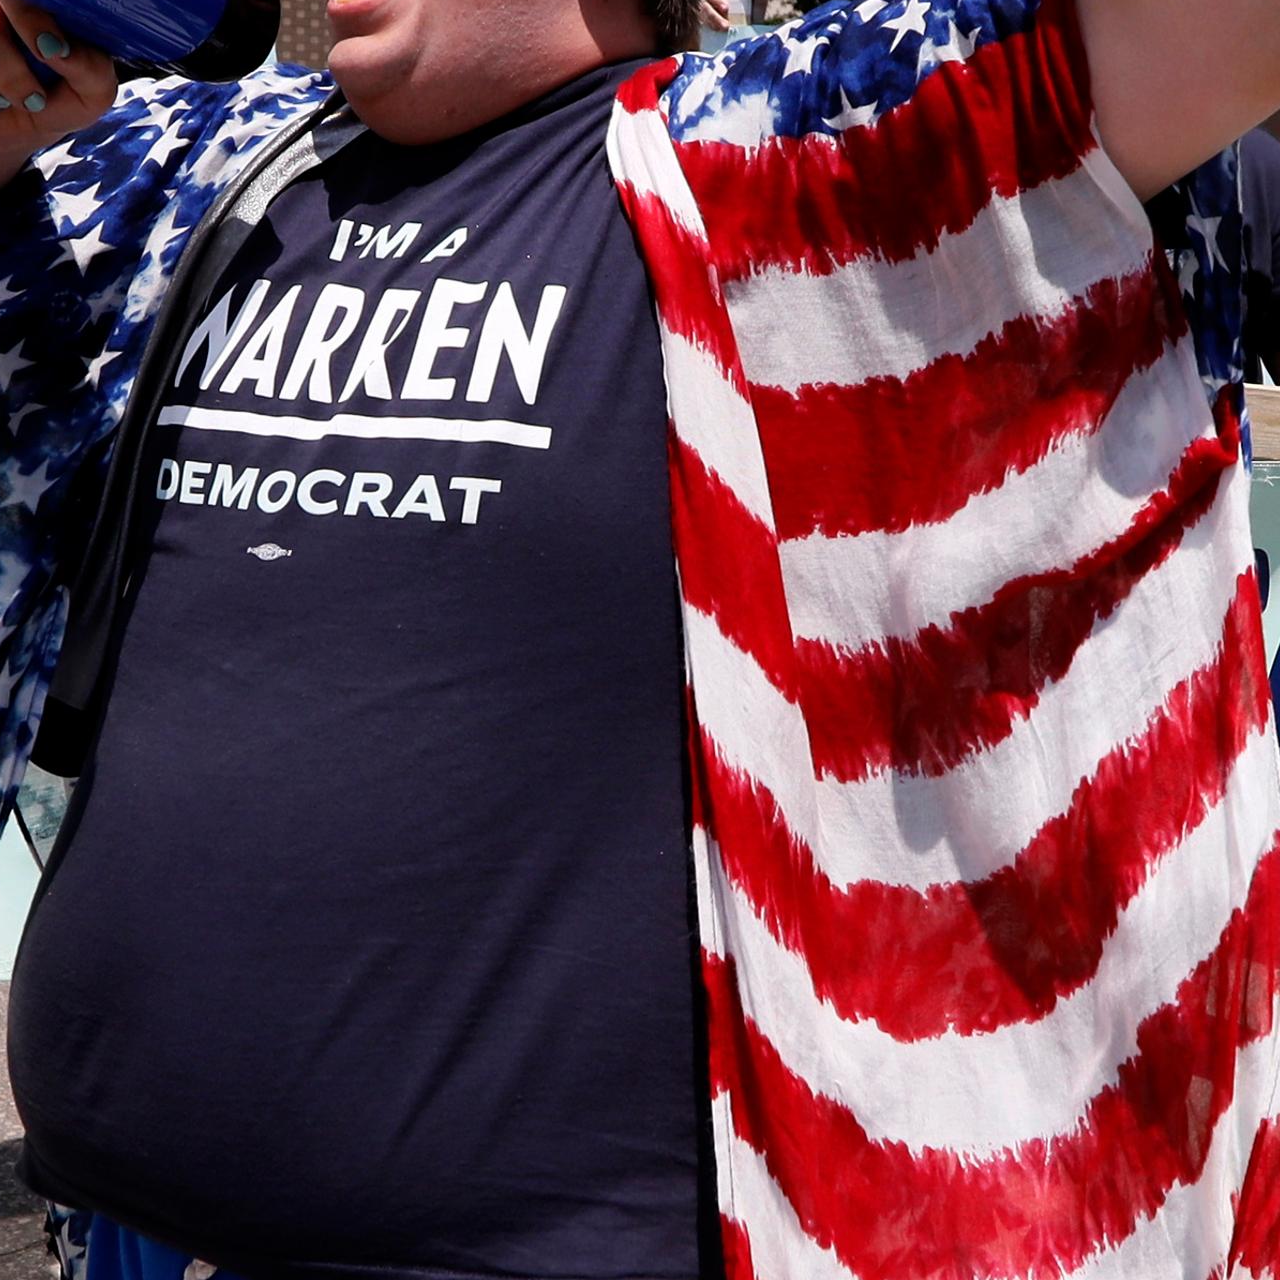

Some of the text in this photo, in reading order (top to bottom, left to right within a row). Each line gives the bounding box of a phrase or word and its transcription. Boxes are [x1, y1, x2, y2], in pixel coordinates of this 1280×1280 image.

[328, 219, 468, 263] I'M A
[156, 458, 502, 525] DEMOCRAT
